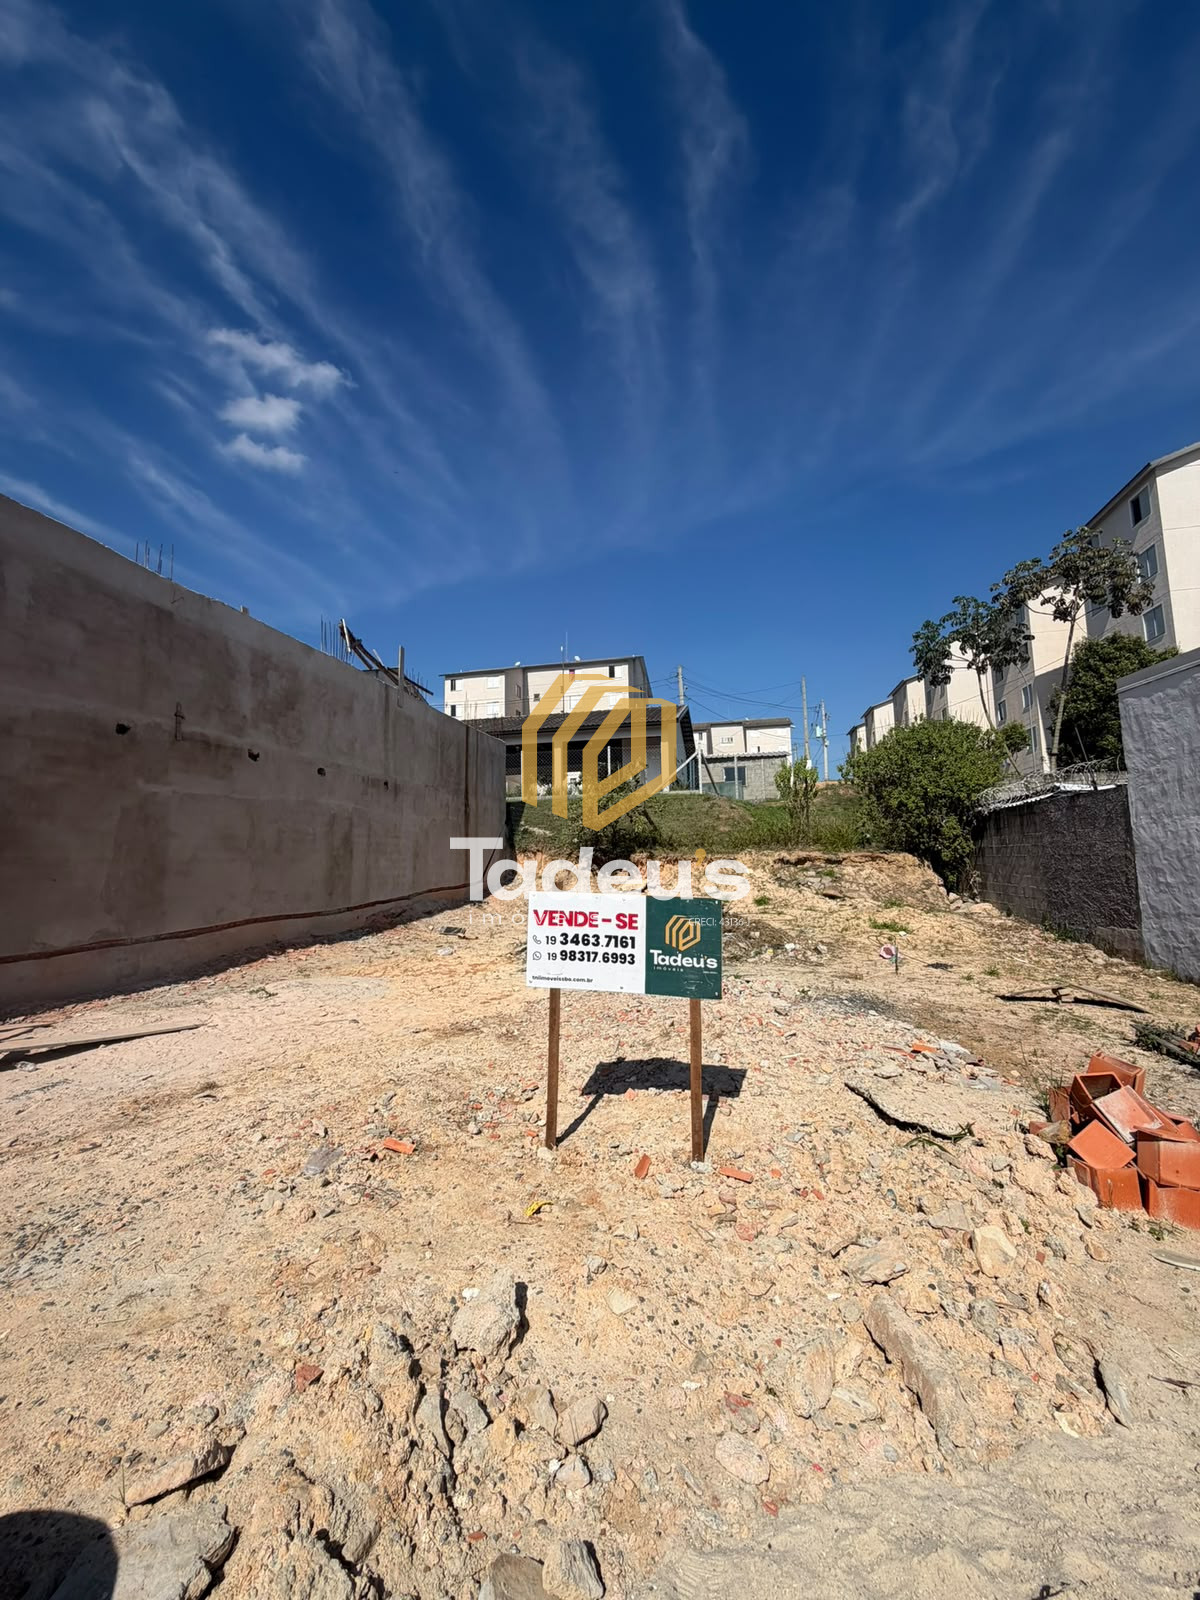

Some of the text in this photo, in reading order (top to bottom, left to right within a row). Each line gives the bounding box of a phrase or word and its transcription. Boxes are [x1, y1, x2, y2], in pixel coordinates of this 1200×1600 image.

[545, 932, 636, 949] 19 3463.7161
[547, 950, 635, 965] 19 98317.6993
[649, 949, 718, 969] Tadeu's
